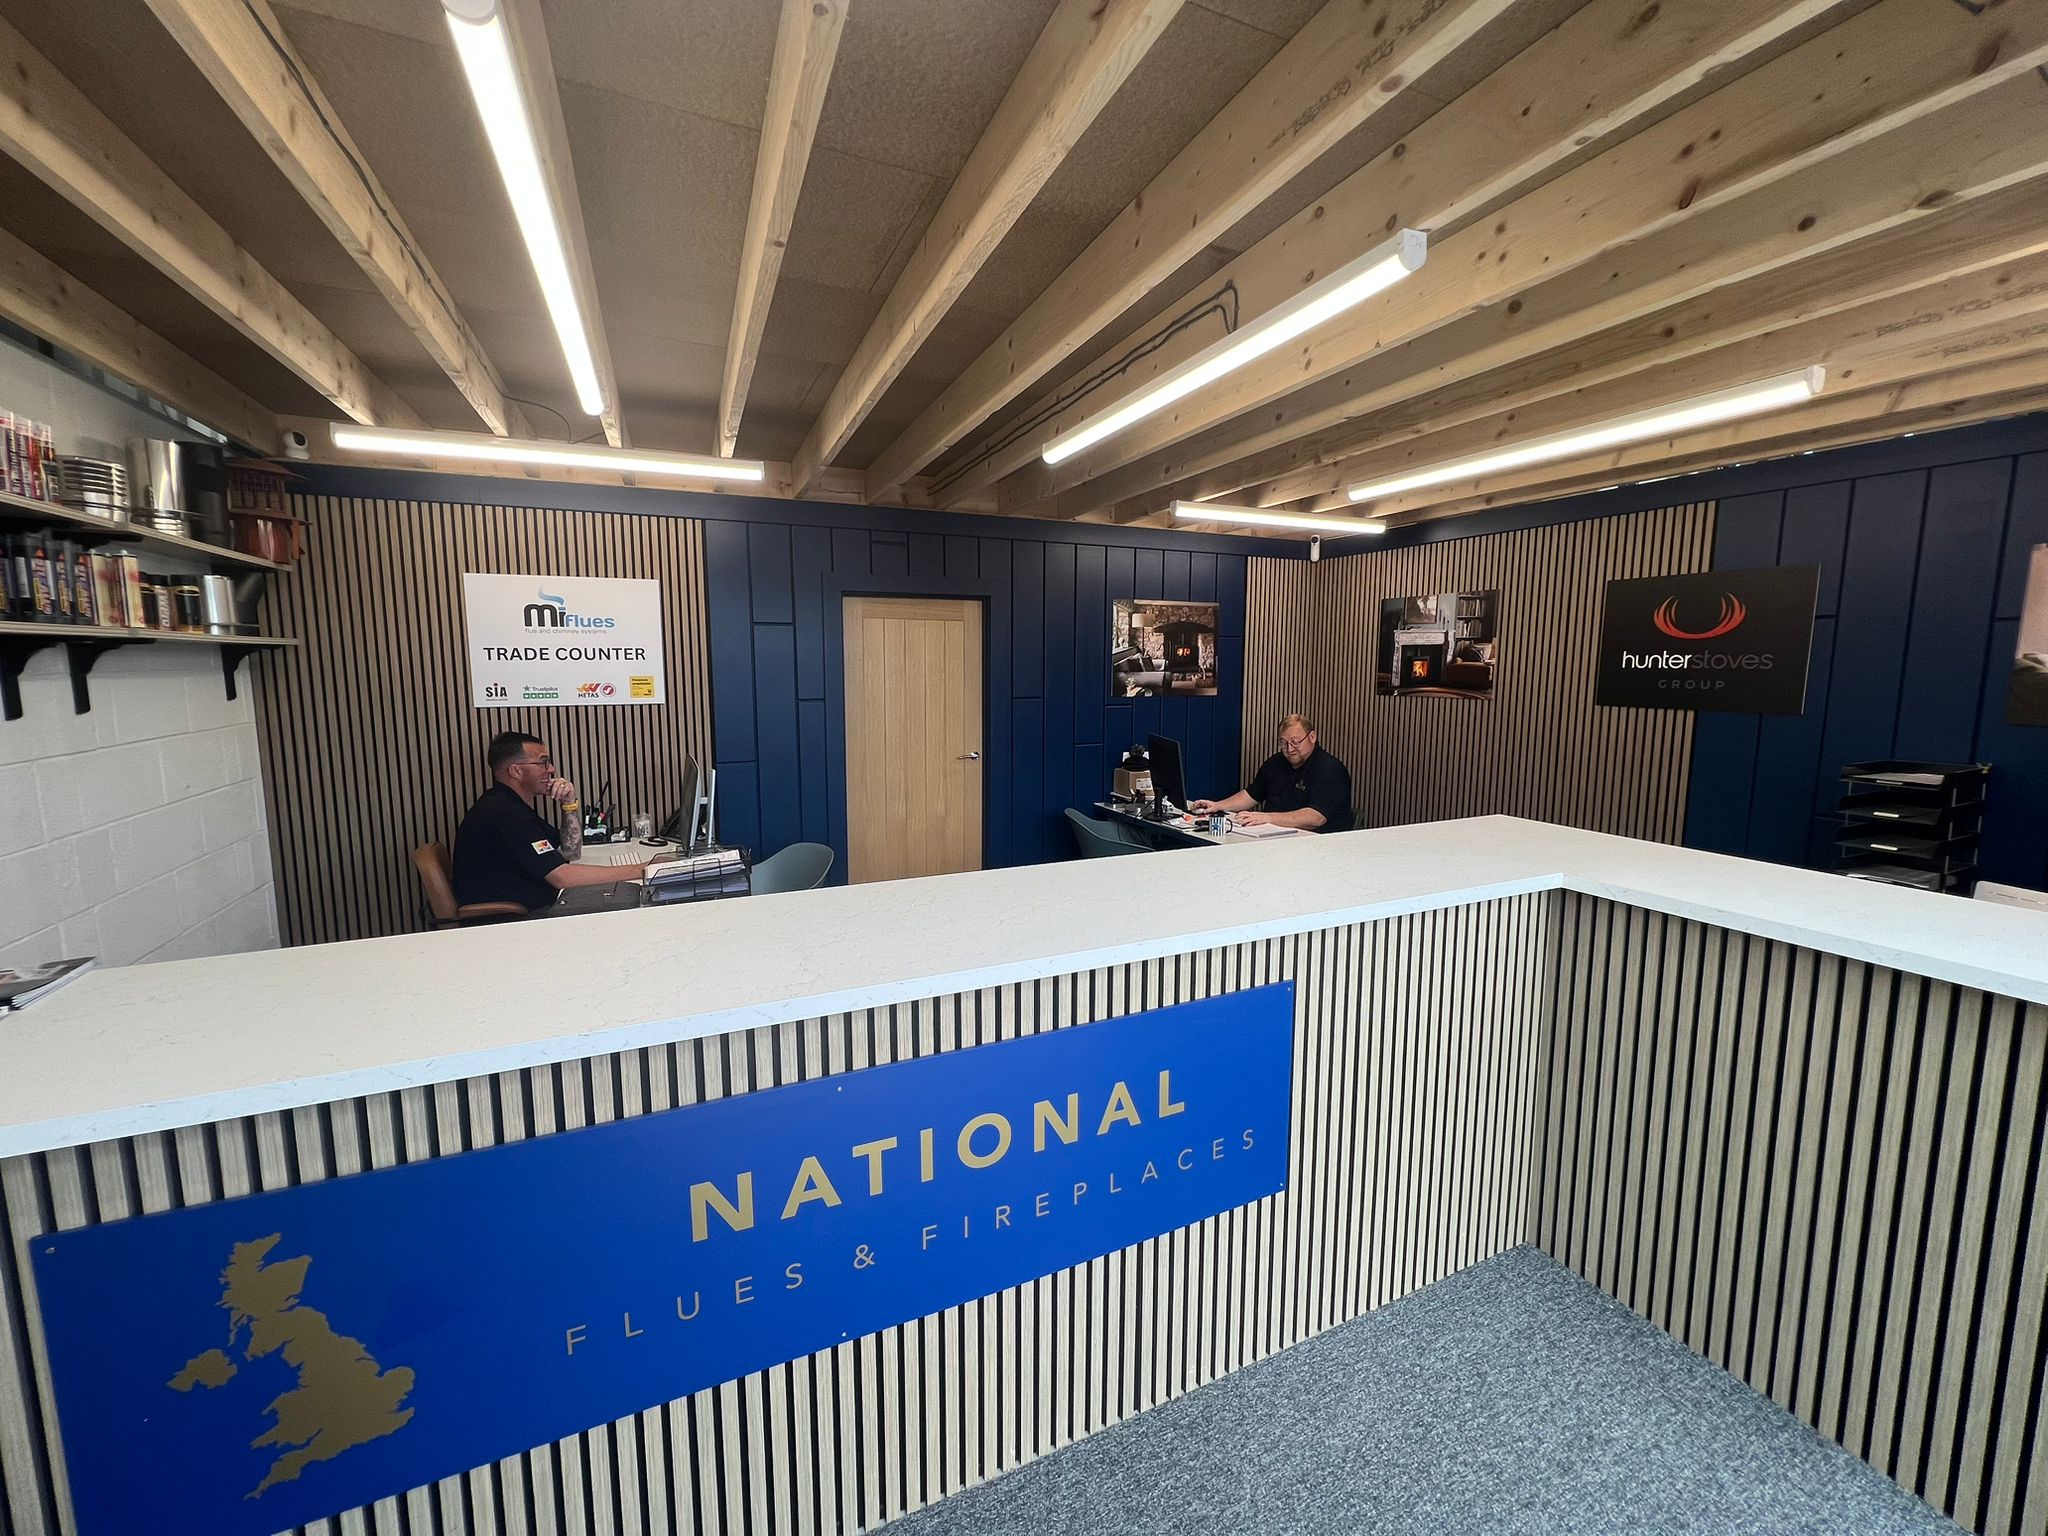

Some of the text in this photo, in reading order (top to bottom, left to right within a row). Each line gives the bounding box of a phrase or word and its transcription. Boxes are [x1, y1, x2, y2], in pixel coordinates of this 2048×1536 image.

[483, 647, 646, 661] TRADE COUNTER
[1622, 650, 1774, 670] hunterstoves
[1658, 679, 1726, 690] GROUP
[690, 1069, 1186, 1243] NATIONAL
[565, 1128, 1255, 1355] FLUES & FIREPLACES
